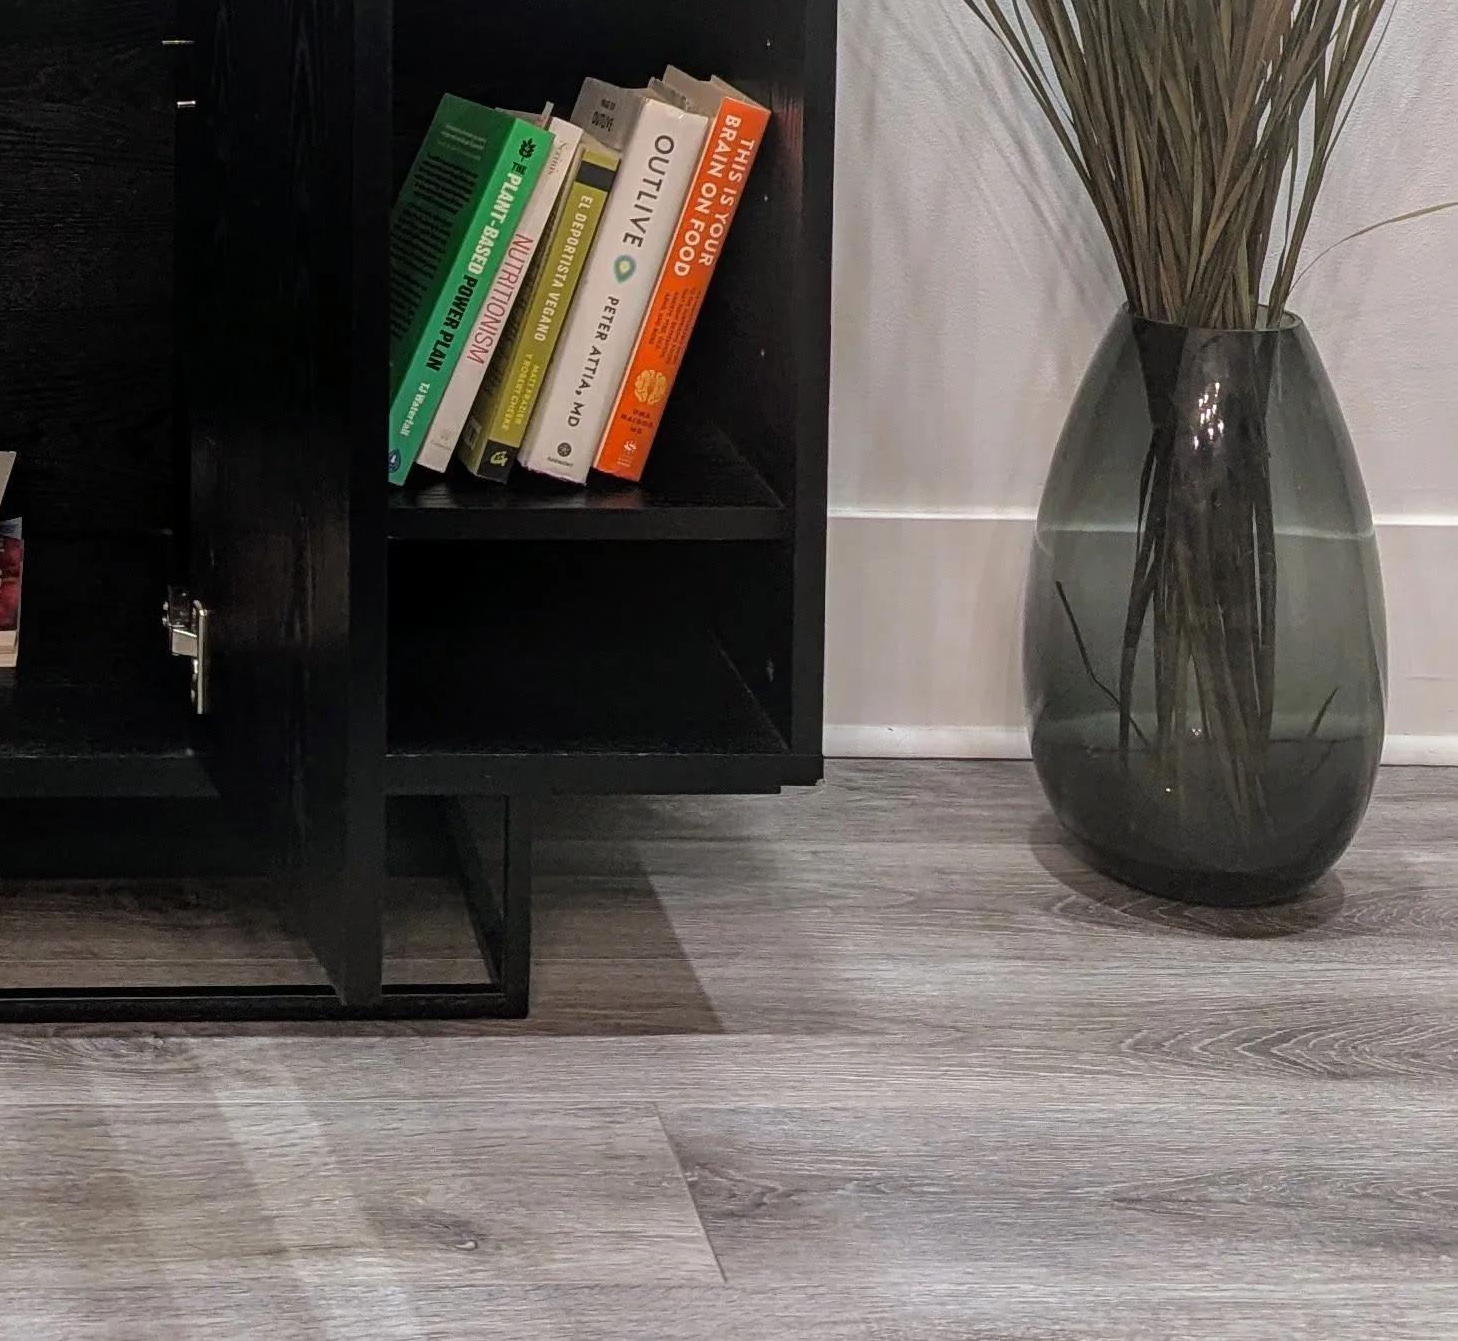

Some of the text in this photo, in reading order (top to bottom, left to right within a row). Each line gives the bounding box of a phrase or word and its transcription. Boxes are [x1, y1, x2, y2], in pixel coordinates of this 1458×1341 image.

[511, 161, 527, 174] THE
[546, 139, 568, 177] Scrinis
[707, 113, 740, 177] BRAIN
[623, 133, 676, 248] OUTLIVE
[694, 180, 717, 215] ON
[698, 136, 754, 267] THIS IS YOUR
[426, 171, 522, 371] PLANT-BASED POWER PLAN
[533, 194, 593, 342] EL DEPORTISTA VEGANO
[673, 217, 705, 277] FOOD
[465, 232, 534, 364] NUTRITIONISM
[566, 295, 620, 428] PETER ATTIA, MD
[400, 381, 430, 437] TJ Waterfall
